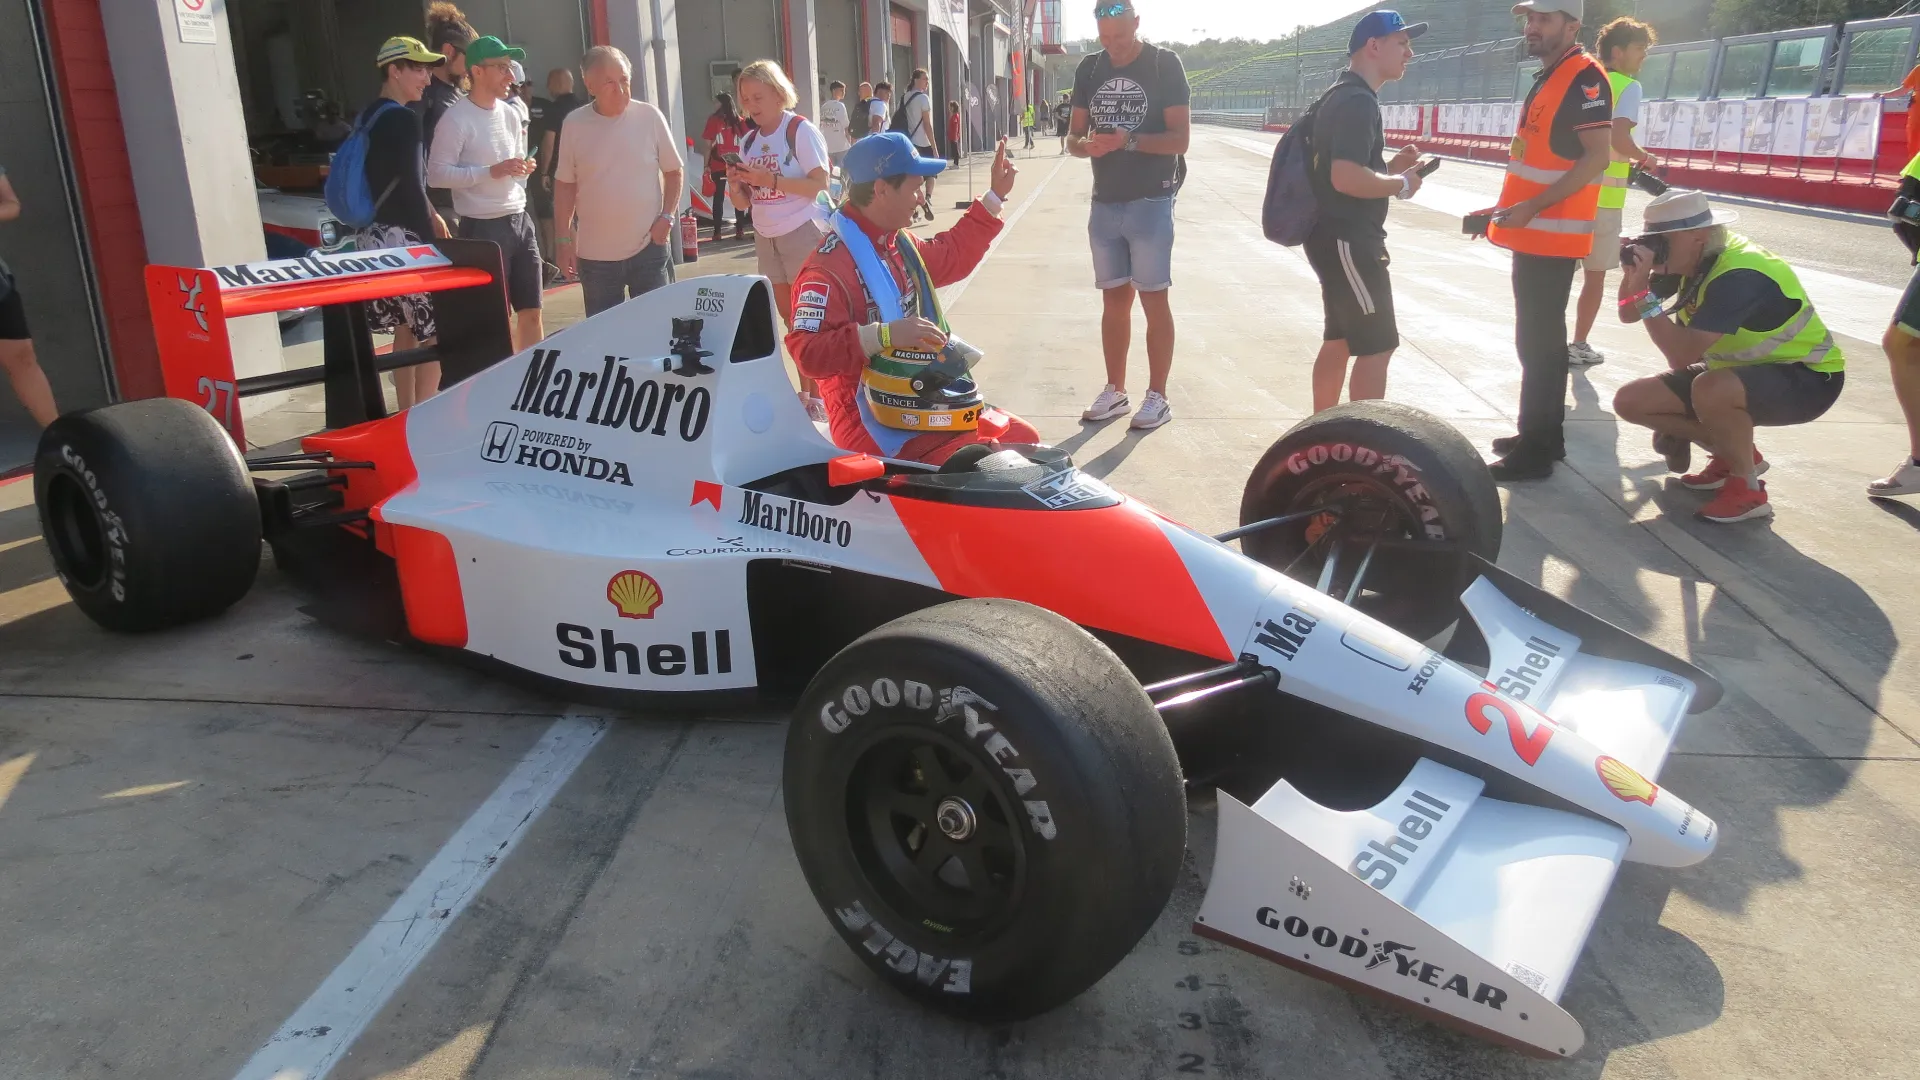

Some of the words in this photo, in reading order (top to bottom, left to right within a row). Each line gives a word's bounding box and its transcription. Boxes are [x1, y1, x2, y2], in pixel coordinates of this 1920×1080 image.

[1121, 101, 1147, 113] Hunt
[211, 252, 407, 288] Marlboro
[695, 298, 725, 313] BOSS
[707, 288, 725, 298] Senna
[796, 309, 823, 318] Shell
[895, 350, 936, 360] NACIONAL
[198, 376, 234, 431] 27
[510, 349, 711, 442] Marlboro
[880, 394, 919, 408] TENCEL
[930, 415, 951, 423] BOSS
[522, 429, 576, 450] POWERED
[577, 438, 592, 454] by
[514, 445, 634, 487] HONDA
[1287, 443, 1445, 542] GOODYEAR
[738, 490, 852, 548] Marlboro
[666, 547, 792, 557] COURTAULDS
[556, 622, 732, 676] Shell
[1495, 635, 1561, 701] Shell
[820, 677, 1057, 841] GOODYEAR
[1347, 789, 1452, 891] Shell
[834, 899, 973, 994] EAGLE
[1256, 906, 1508, 1010] GOODYEAR
[1177, 1012, 1202, 1030] 3
[1176, 1053, 1205, 1074] 2
